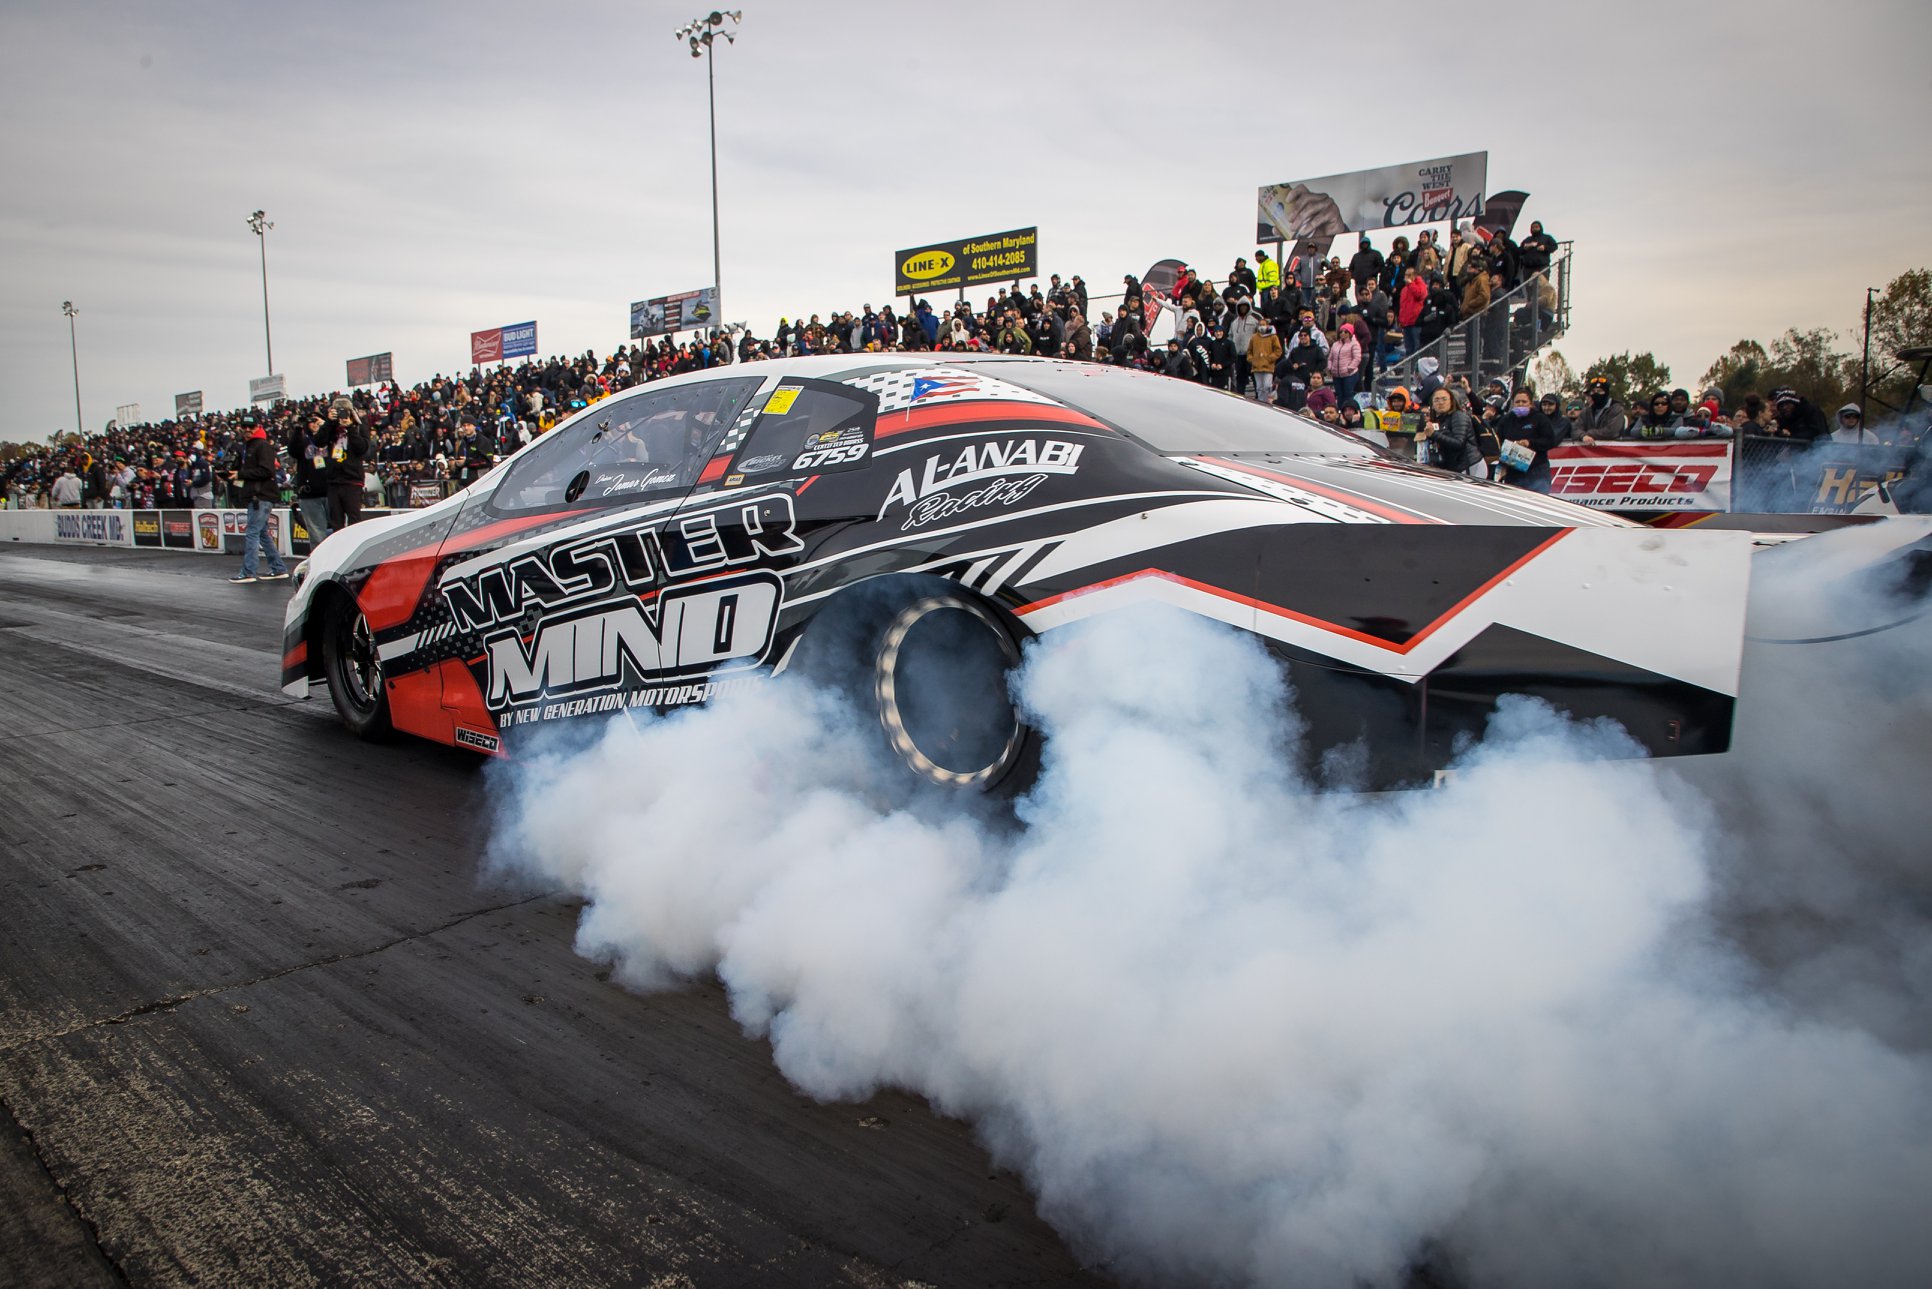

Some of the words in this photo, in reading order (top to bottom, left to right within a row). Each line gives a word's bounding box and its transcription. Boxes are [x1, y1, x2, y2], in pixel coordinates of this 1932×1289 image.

[1419, 165, 1453, 176] CARRY
[1431, 173, 1451, 182] THE
[1423, 181, 1450, 190] WEST
[1383, 191, 1483, 228] Coors
[962, 244, 970, 255] of
[971, 241, 1001, 254] Southern
[1003, 233, 1035, 248] Maryland
[972, 250, 1025, 270] 410-414-2085
[504, 331, 517, 341] BUD
[517, 328, 534, 340] LIGHT
[792, 443, 869, 470] 6759
[876, 440, 1085, 522] AL-ANABI
[901, 473, 1048, 531] Racing
[1620, 496, 1694, 506] Products
[57, 515, 80, 539] BUDDS
[82, 515, 107, 540] CREEK
[442, 493, 804, 634] MASTER
[485, 570, 783, 709] MIND
[500, 714, 512, 727] BY
[516, 708, 541, 724] NEW
[543, 692, 625, 720] GENERATION
